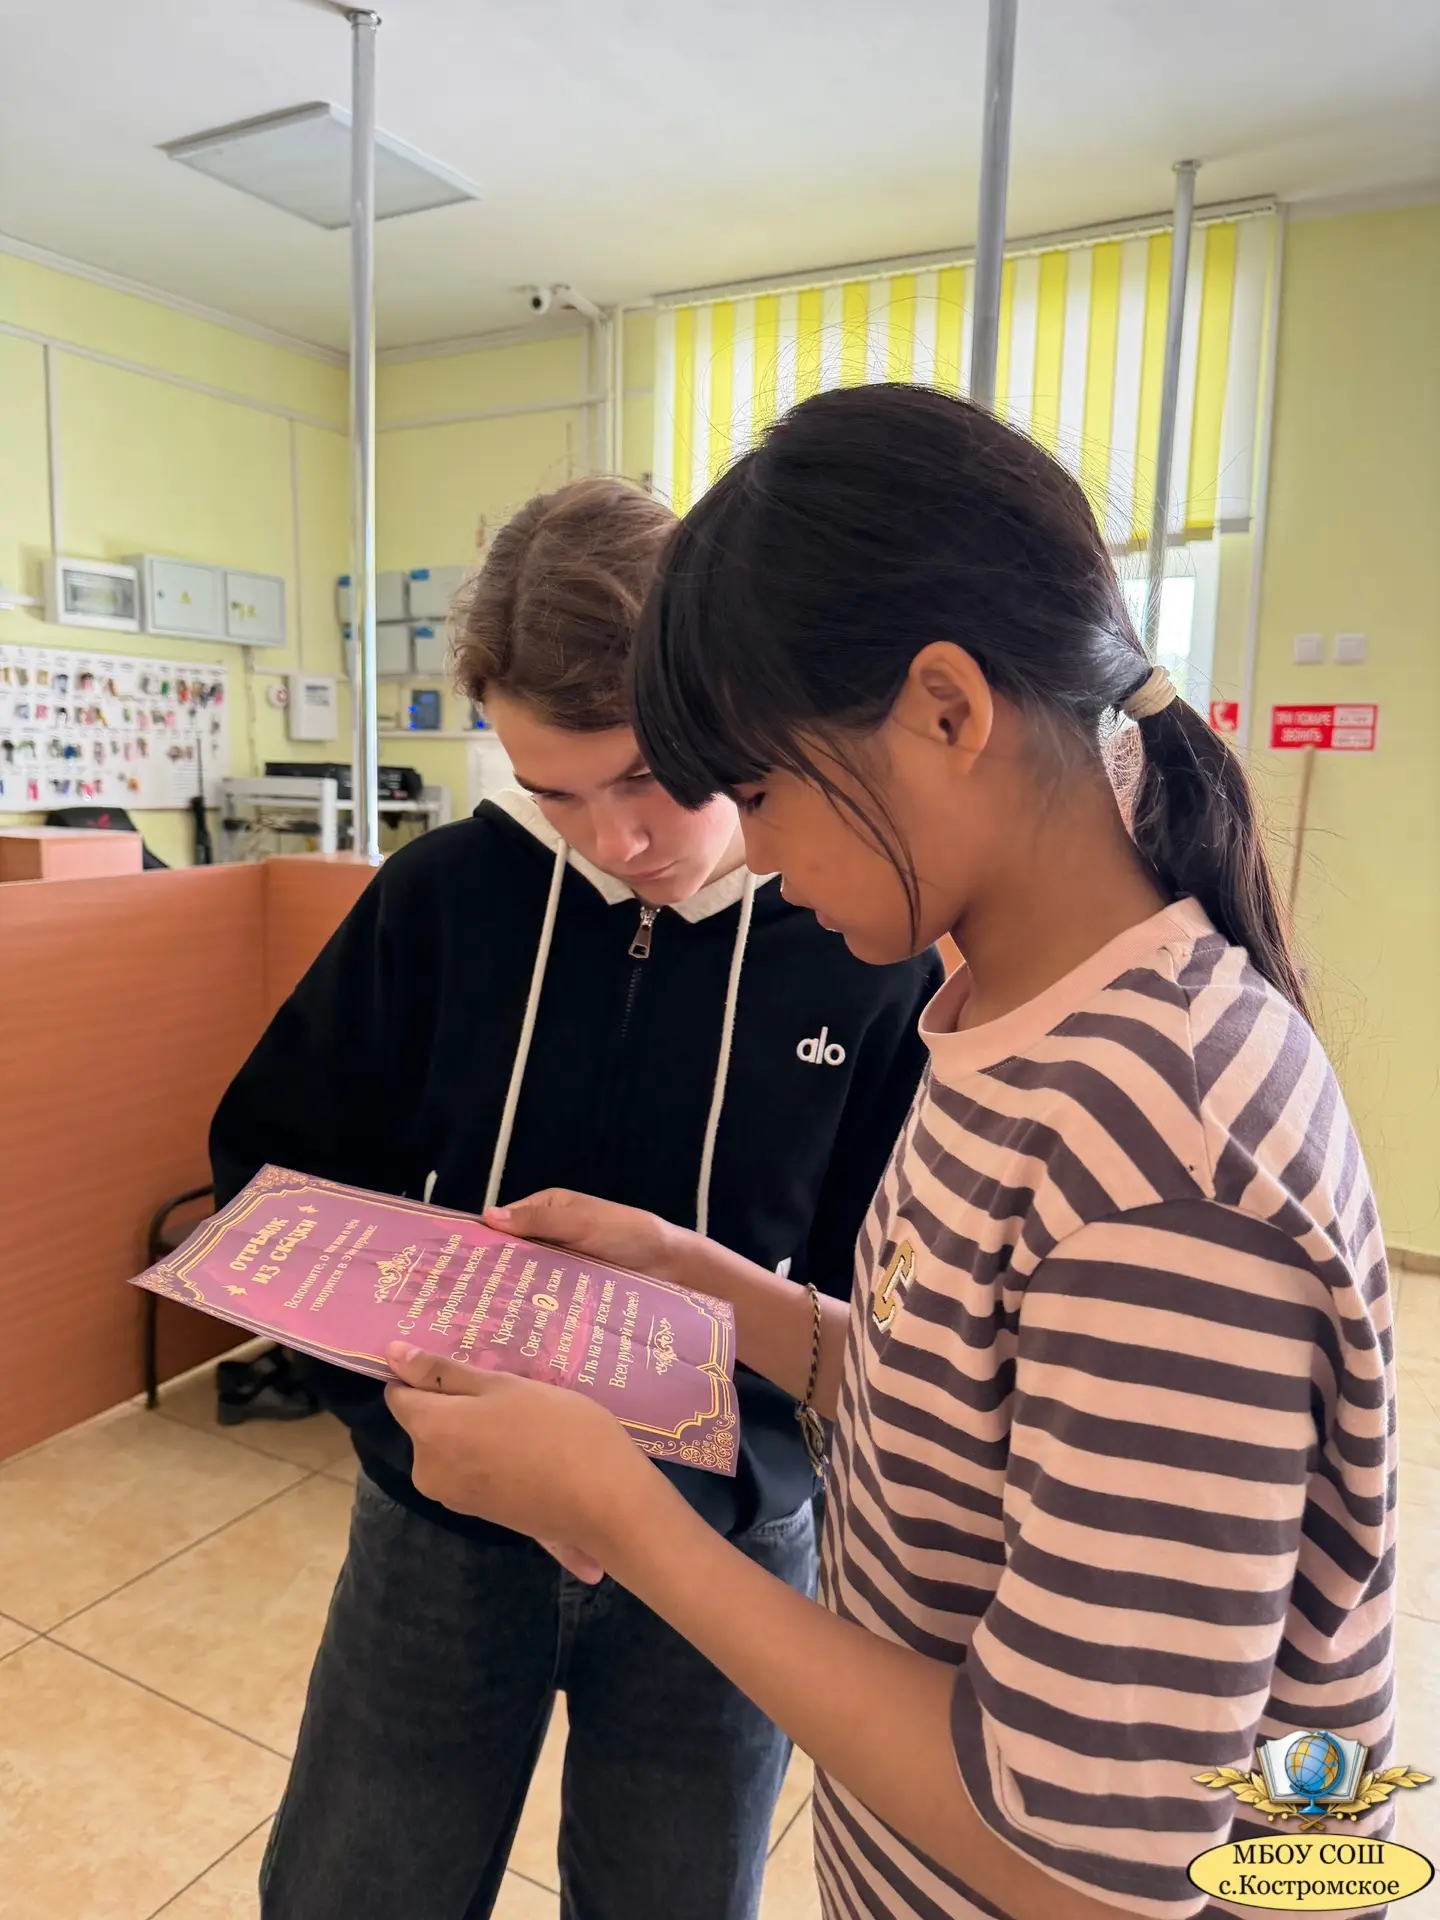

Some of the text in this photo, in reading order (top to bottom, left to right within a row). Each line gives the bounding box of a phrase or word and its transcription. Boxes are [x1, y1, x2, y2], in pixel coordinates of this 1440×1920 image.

[796, 1026, 846, 1066] alo
[229, 1217, 289, 1271] ОТРЫВОК
[251, 1219, 318, 1284] ИЗ СКАЗКИ
[440, 1234, 463, 1254] была
[434, 1255, 452, 1271] она
[283, 1263, 327, 1308] Вспомните,
[309, 1269, 344, 1312] говорится
[407, 1297, 429, 1319] ним
[596, 1303, 611, 1325] всех
[459, 1324, 481, 1350] ним
[520, 1329, 543, 1357] Свет
[557, 1332, 574, 1353] всю
[451, 1351, 470, 1363] С
[549, 1354, 570, 1372] Да
[588, 1345, 602, 1359] на
[584, 1360, 599, 1374] ль
[609, 1362, 629, 1388] Всех
[578, 1372, 595, 1386] Я
